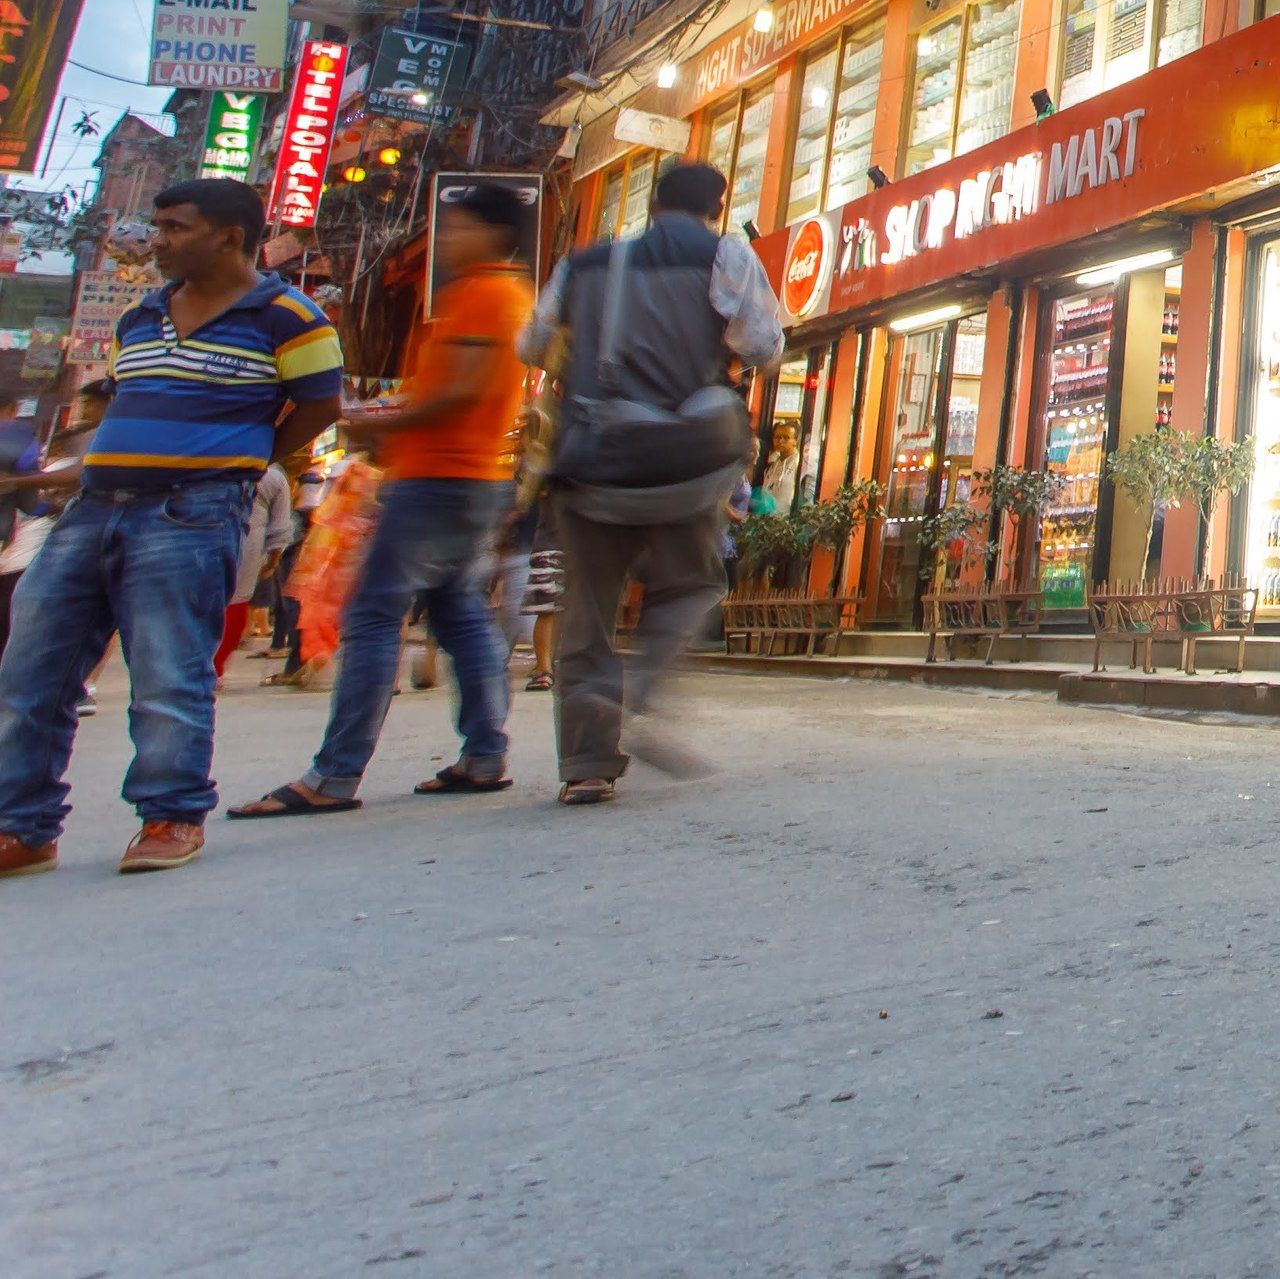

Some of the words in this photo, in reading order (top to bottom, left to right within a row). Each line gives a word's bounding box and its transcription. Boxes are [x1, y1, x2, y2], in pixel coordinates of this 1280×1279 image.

[156, 13, 247, 37] PRINT
[154, 40, 257, 63] PHONE
[152, 63, 277, 88] LAUNDRY
[881, 188, 957, 266] SHOP
[1046, 108, 1147, 205] MART
